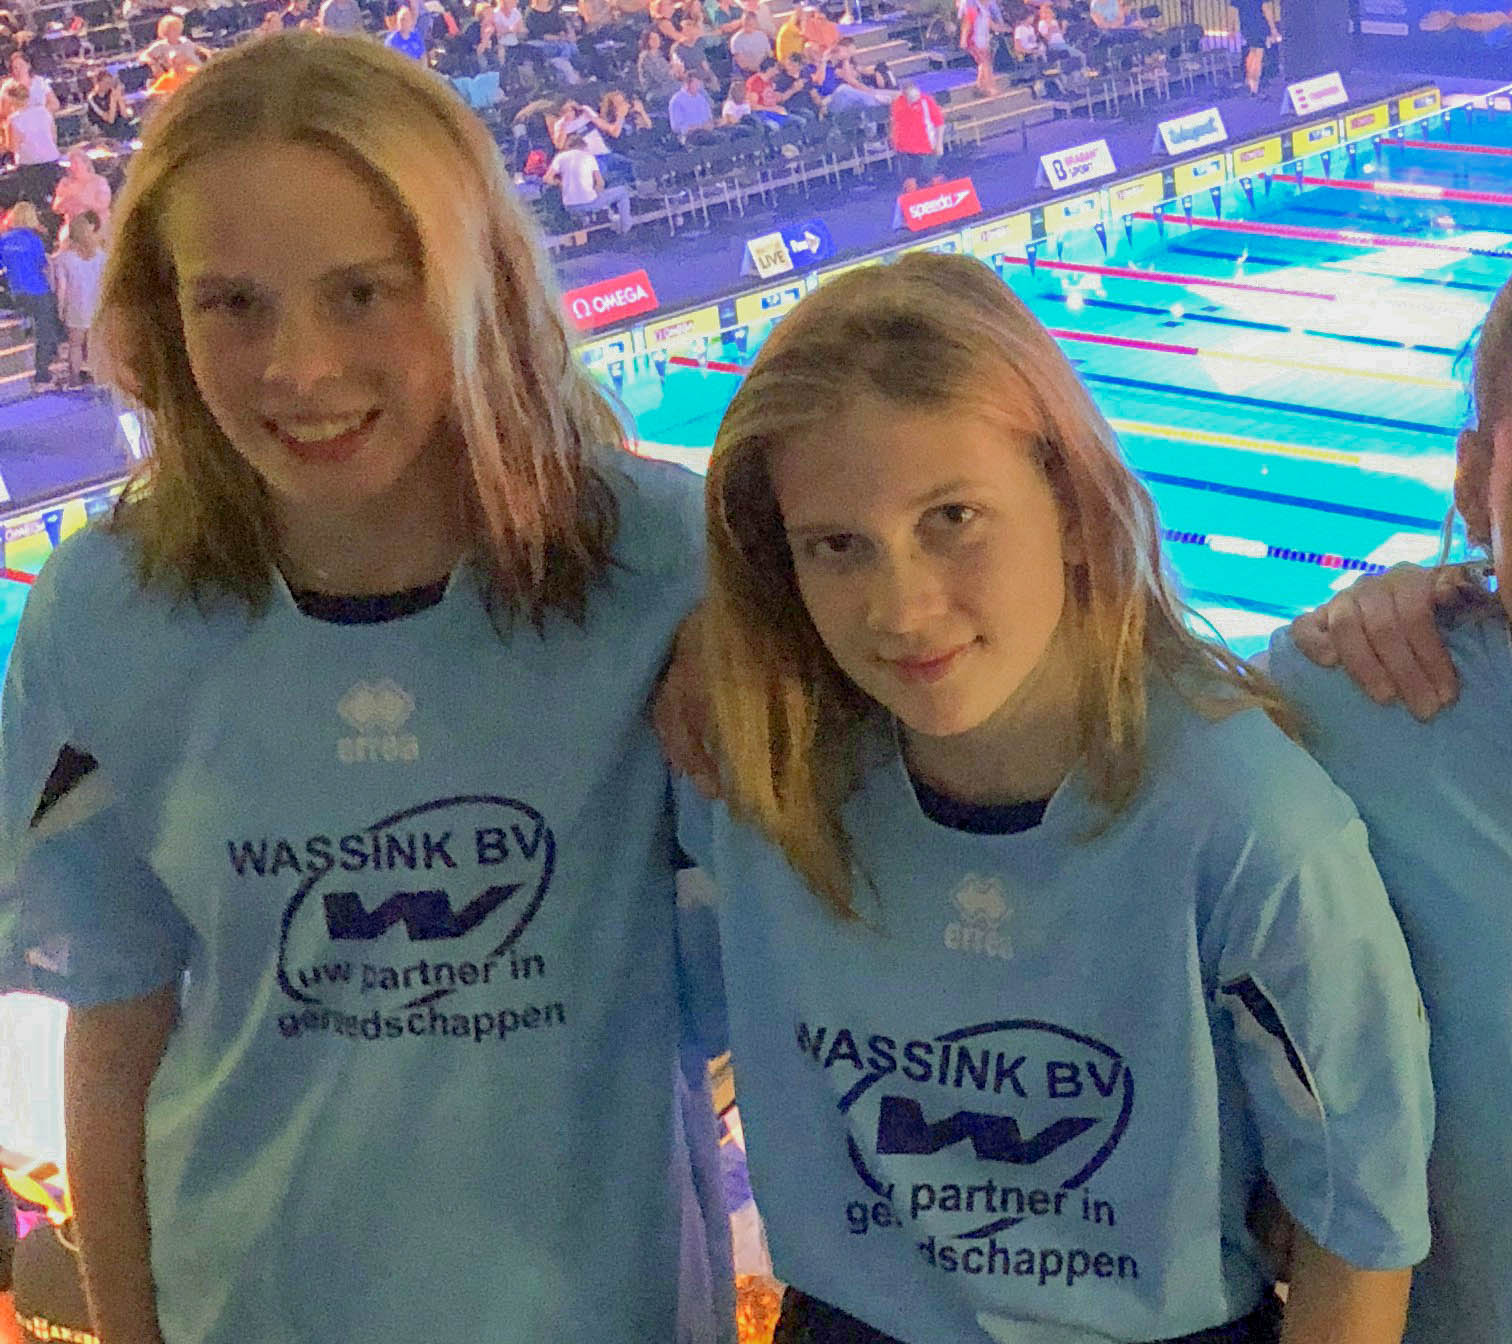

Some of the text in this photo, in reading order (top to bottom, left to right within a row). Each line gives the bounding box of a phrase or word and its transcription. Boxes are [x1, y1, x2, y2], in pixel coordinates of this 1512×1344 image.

[757, 250, 786, 270] LIVE
[591, 284, 649, 313] OMEGA
[227, 823, 546, 877] WASSINK BV
[361, 956, 496, 994] partner
[510, 950, 546, 980] in
[1046, 1058, 1122, 1099] BV
[911, 1178, 1116, 1227] partner in
